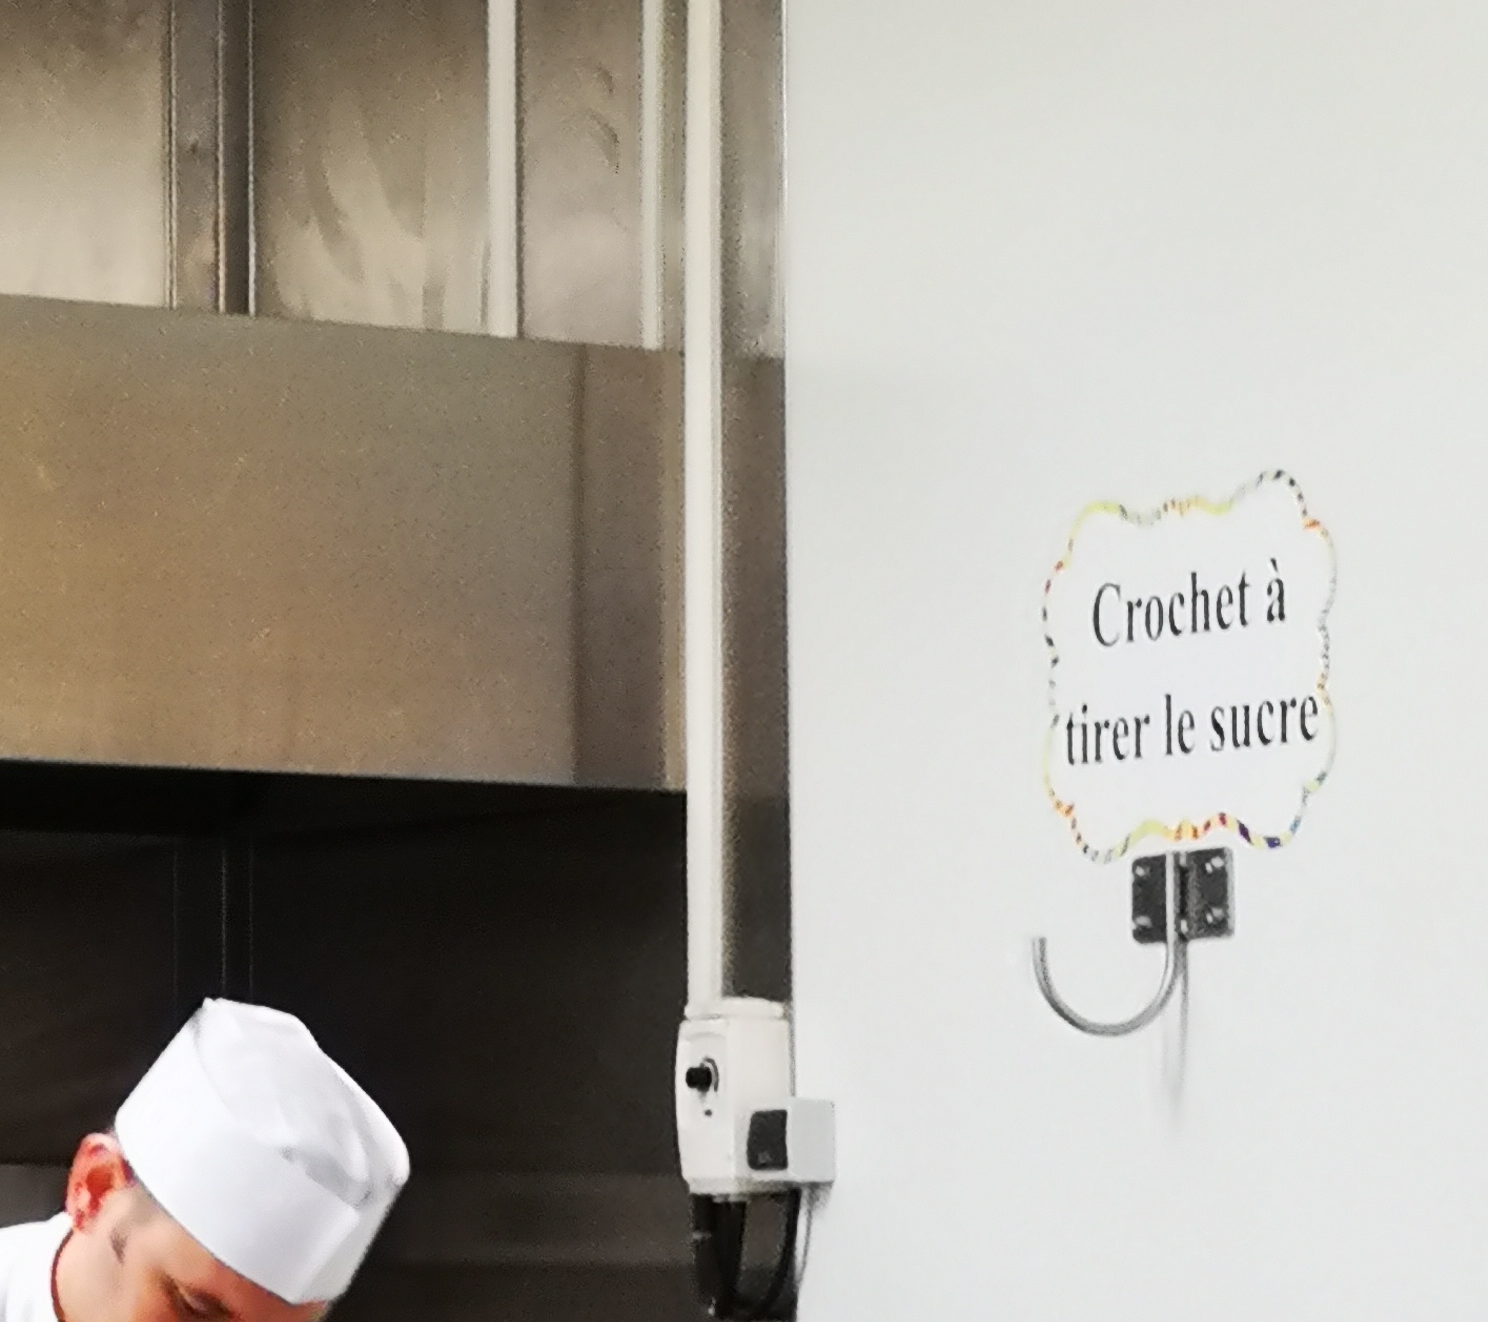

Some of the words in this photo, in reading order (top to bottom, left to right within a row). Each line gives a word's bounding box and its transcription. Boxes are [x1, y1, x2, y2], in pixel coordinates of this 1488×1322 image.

[1092, 571, 1250, 647] Crochet
[1266, 557, 1286, 623] à
[1066, 703, 1150, 765] tirer
[1164, 693, 1195, 756] le
[1210, 695, 1318, 752] sucre
